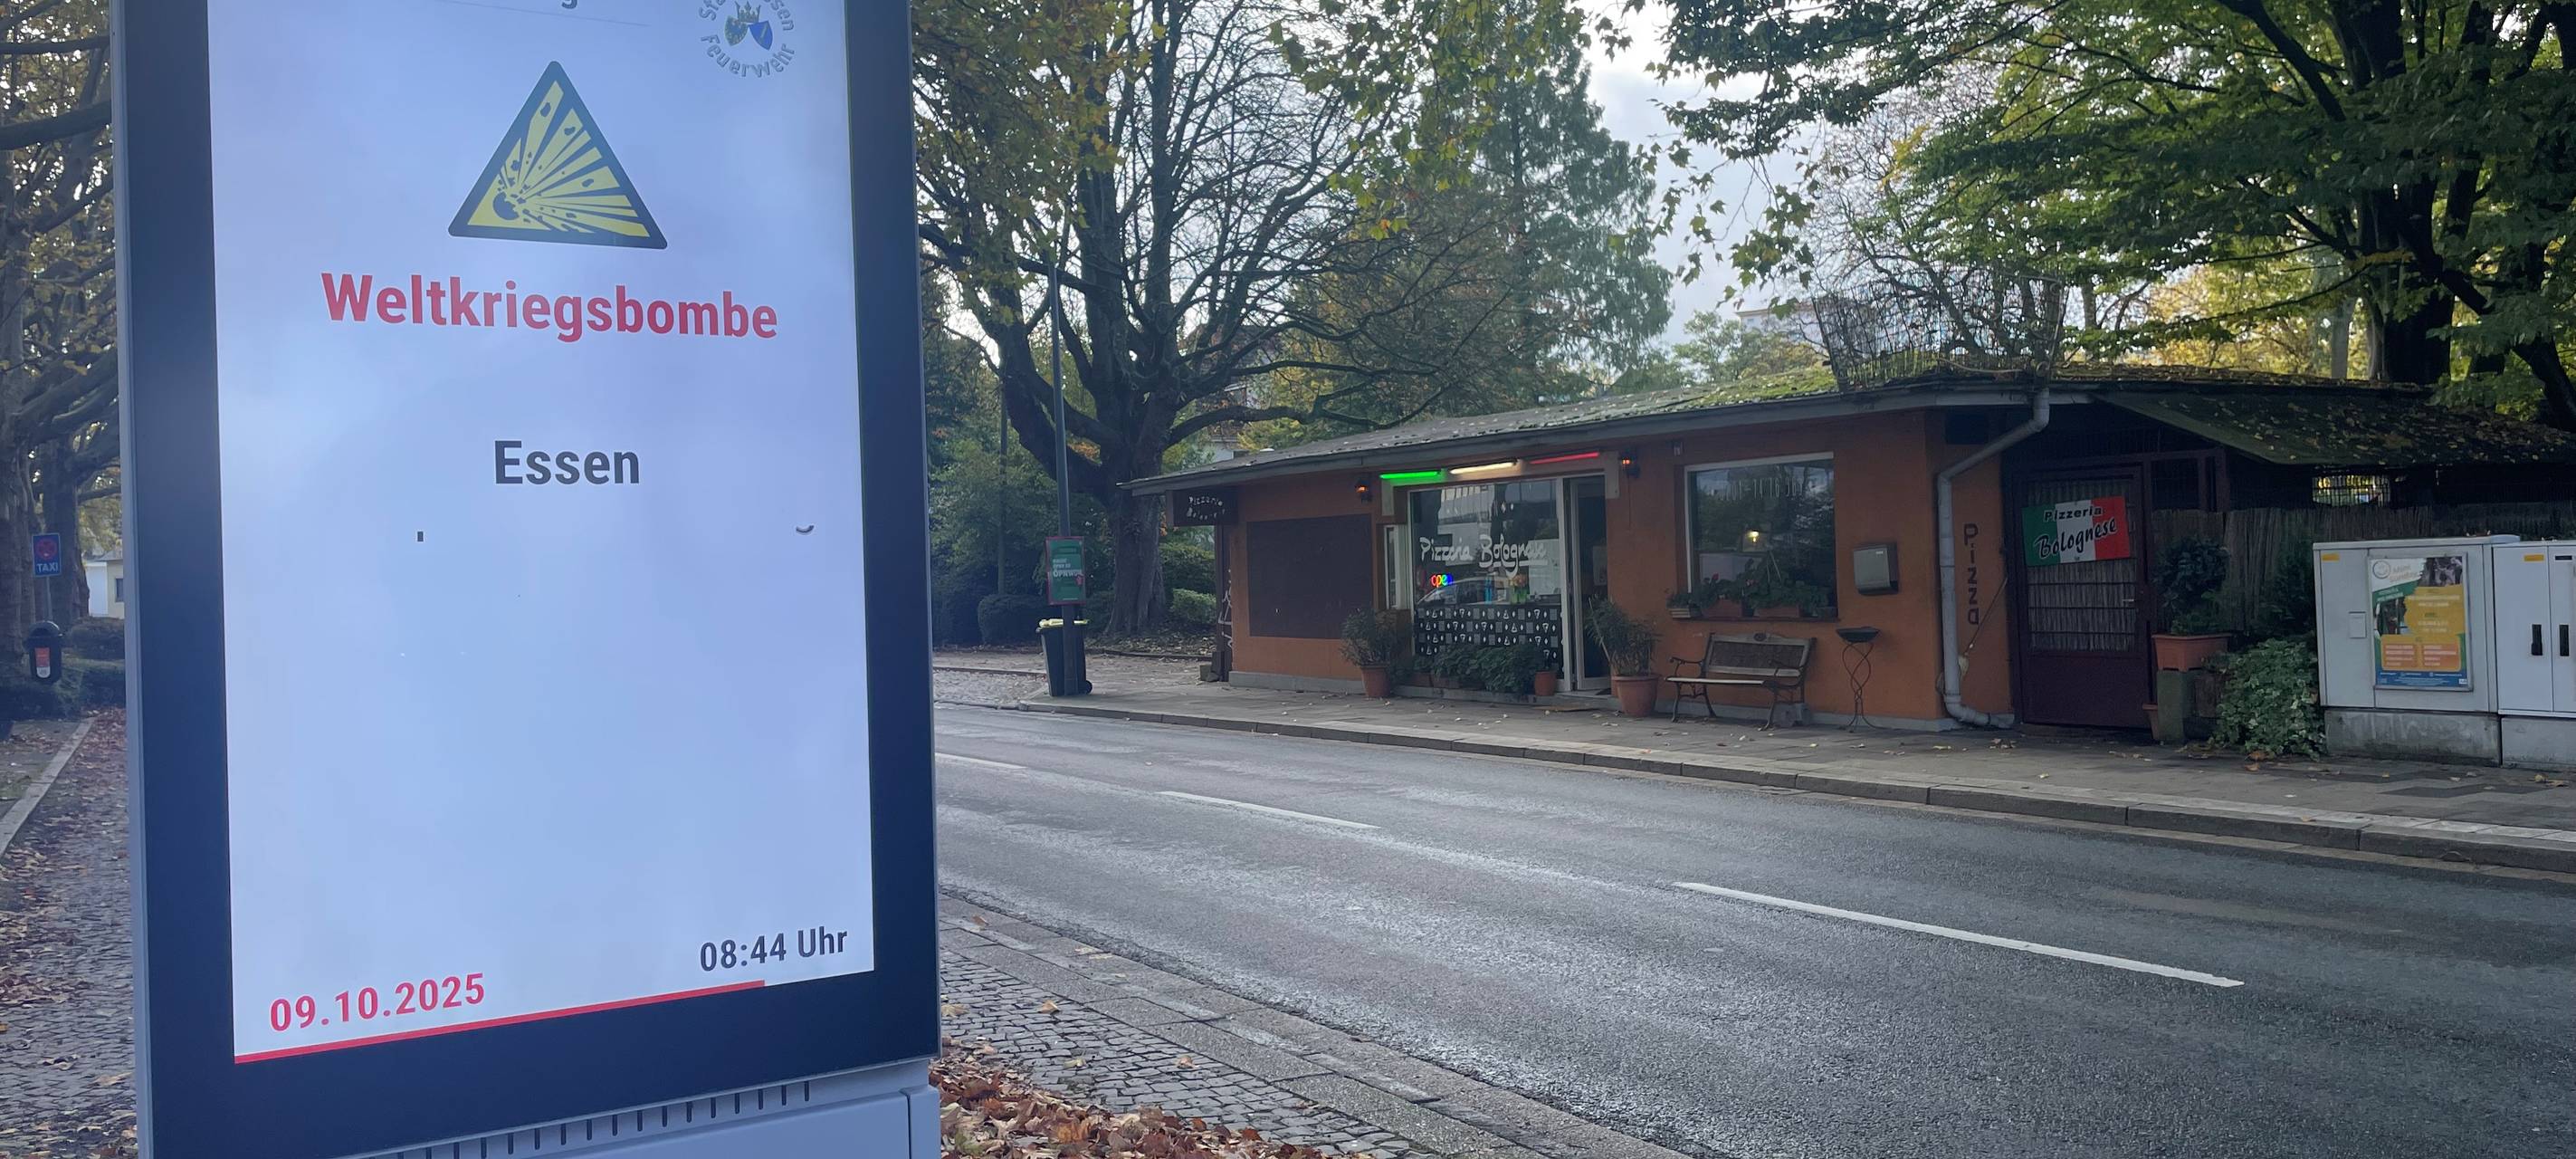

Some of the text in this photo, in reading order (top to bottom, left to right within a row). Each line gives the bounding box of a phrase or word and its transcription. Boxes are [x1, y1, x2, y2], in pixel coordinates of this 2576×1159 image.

[701, 34, 795, 78] Feuerwehr
[320, 272, 778, 342] Weltkriegsbombe
[495, 440, 640, 484] Essen
[2044, 504, 2103, 522] Pizzeria
[2034, 517, 2118, 559] Bolognese
[36, 562, 59, 573] TAXI
[701, 925, 848, 972] 08:44 Uhr
[270, 972, 485, 1031] 09.10.2025
